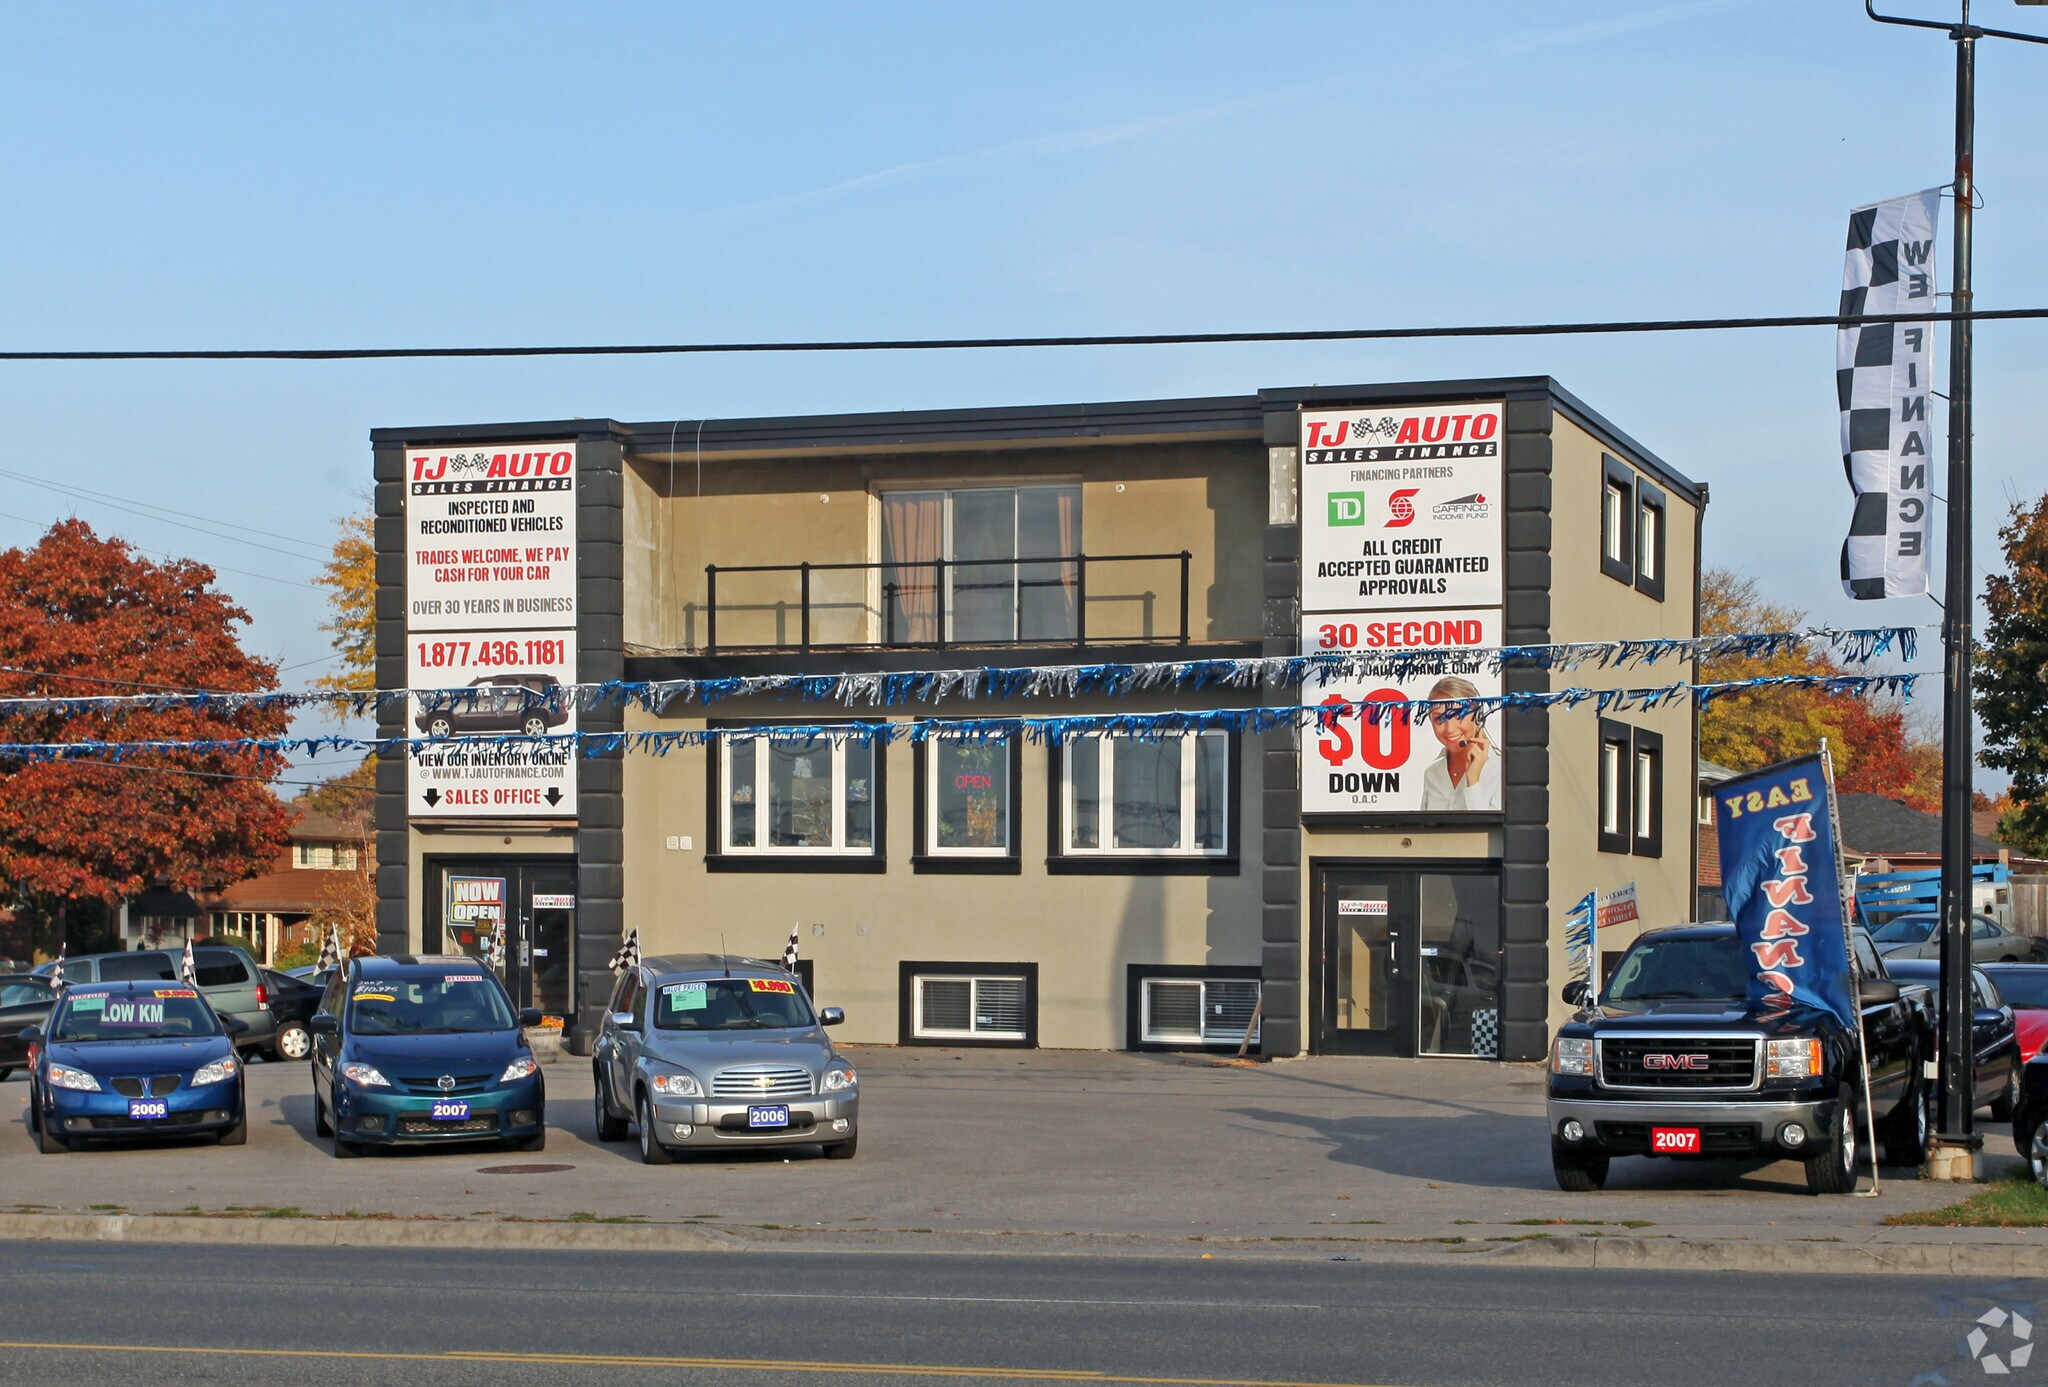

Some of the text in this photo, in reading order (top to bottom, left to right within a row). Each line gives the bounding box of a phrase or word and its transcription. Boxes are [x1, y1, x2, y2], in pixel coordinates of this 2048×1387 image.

[1307, 413, 1498, 448] TJ AUTO
[1308, 444, 1494, 462] SALES FINANCE
[412, 451, 573, 480] TJ AUTO
[1350, 466, 1454, 482] FINANCING PARTNERS
[413, 479, 570, 494] SALES FINANCE
[448, 499, 535, 516] INSPECTED AND
[1331, 498, 1361, 520] TD
[1432, 503, 1489, 513] CARFINCO
[421, 516, 563, 535] RECONDITIONED VEHICLES
[415, 547, 570, 565] TRADES WELCOME, WE PAY
[1362, 538, 1443, 556] ALL CREDIT
[434, 565, 551, 583] CASH FOR YOUR CAR
[1317, 556, 1489, 578] ACCEPTED GUARANTEED
[1359, 578, 1447, 596] APPROVALS
[412, 597, 573, 615] OVER 30 YEARS IN BUSINESS
[1318, 620, 1482, 648] 30 SECOND
[417, 640, 565, 668] 1.877.436.1181
[1318, 688, 1411, 770] $0
[417, 752, 568, 767] VIEW OUR INVENTORY ONLINE
[432, 767, 564, 780] WWW.TJAUTOFINANCE.COM
[954, 775, 992, 789] OPEN
[1329, 772, 1400, 793] DOWN
[445, 788, 541, 805] SALES OFFICE
[456, 881, 500, 901] NOW
[453, 905, 500, 920] OPEN
[663, 982, 706, 995] VALUE PRICED
[101, 1003, 135, 1022] LOW
[139, 1004, 163, 1023] KM
[1643, 1054, 1709, 1069] GMC
[131, 1103, 166, 1116] 2006
[433, 1104, 468, 1116] 2007
[752, 1110, 785, 1123] 2006
[1655, 1132, 1696, 1148] 2007
